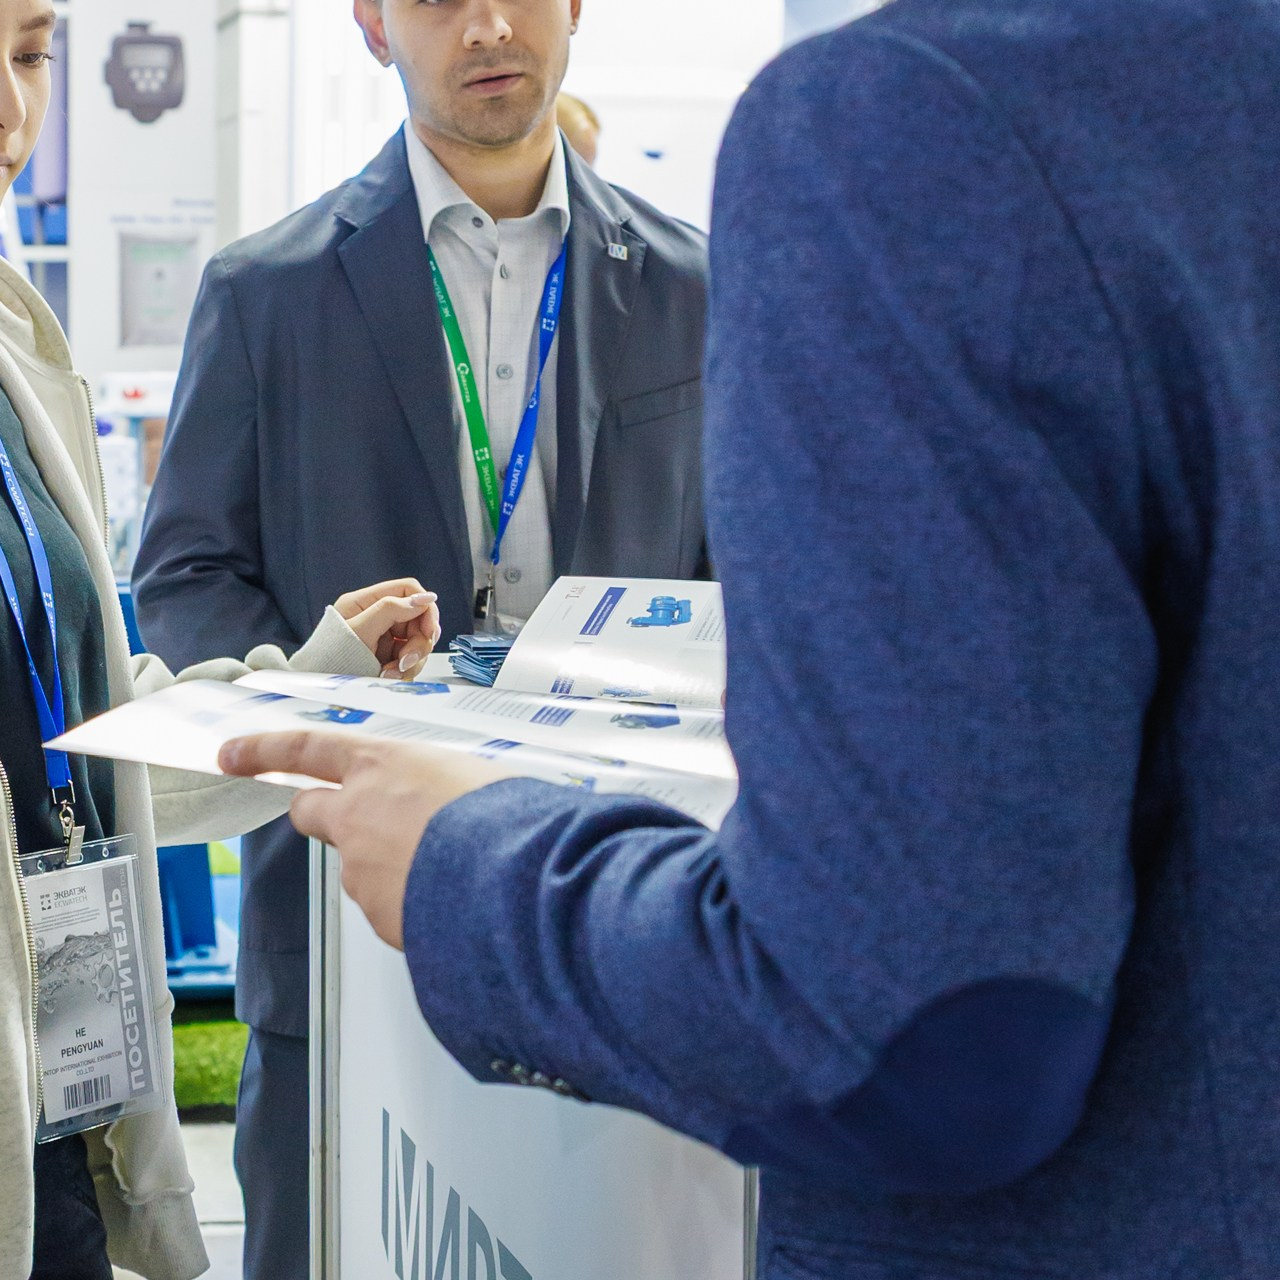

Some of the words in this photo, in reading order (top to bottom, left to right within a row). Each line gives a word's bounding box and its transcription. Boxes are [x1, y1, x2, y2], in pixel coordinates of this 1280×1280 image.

[4, 470, 35, 537] ECWATECH
[52, 885, 87, 901] ЭКВАТЭК
[53, 894, 88, 909] ECWATECH
[108, 887, 147, 1091] ПОСЕТИТЕЛЬ
[75, 1027, 87, 1038] HE
[61, 1038, 104, 1058] PENGYUAN
[60, 1058, 96, 1073] INTERNATIONAL
